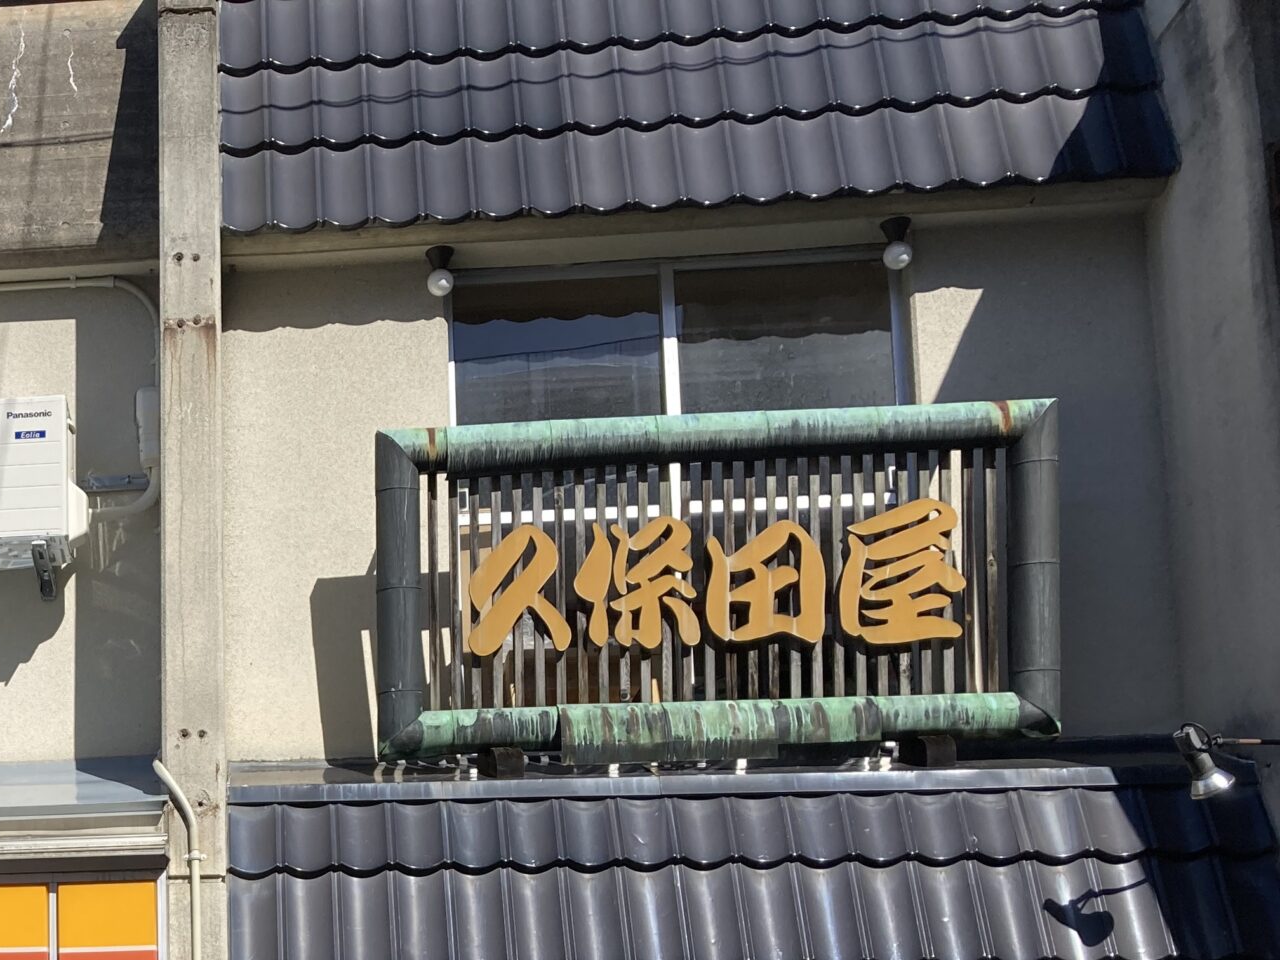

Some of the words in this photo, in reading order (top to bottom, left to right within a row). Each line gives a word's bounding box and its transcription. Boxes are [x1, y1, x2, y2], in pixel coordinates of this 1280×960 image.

[6, 409, 53, 420] Panasonic
[20, 430, 40, 439] Eolia
[468, 498, 967, 657] 久保田屋
